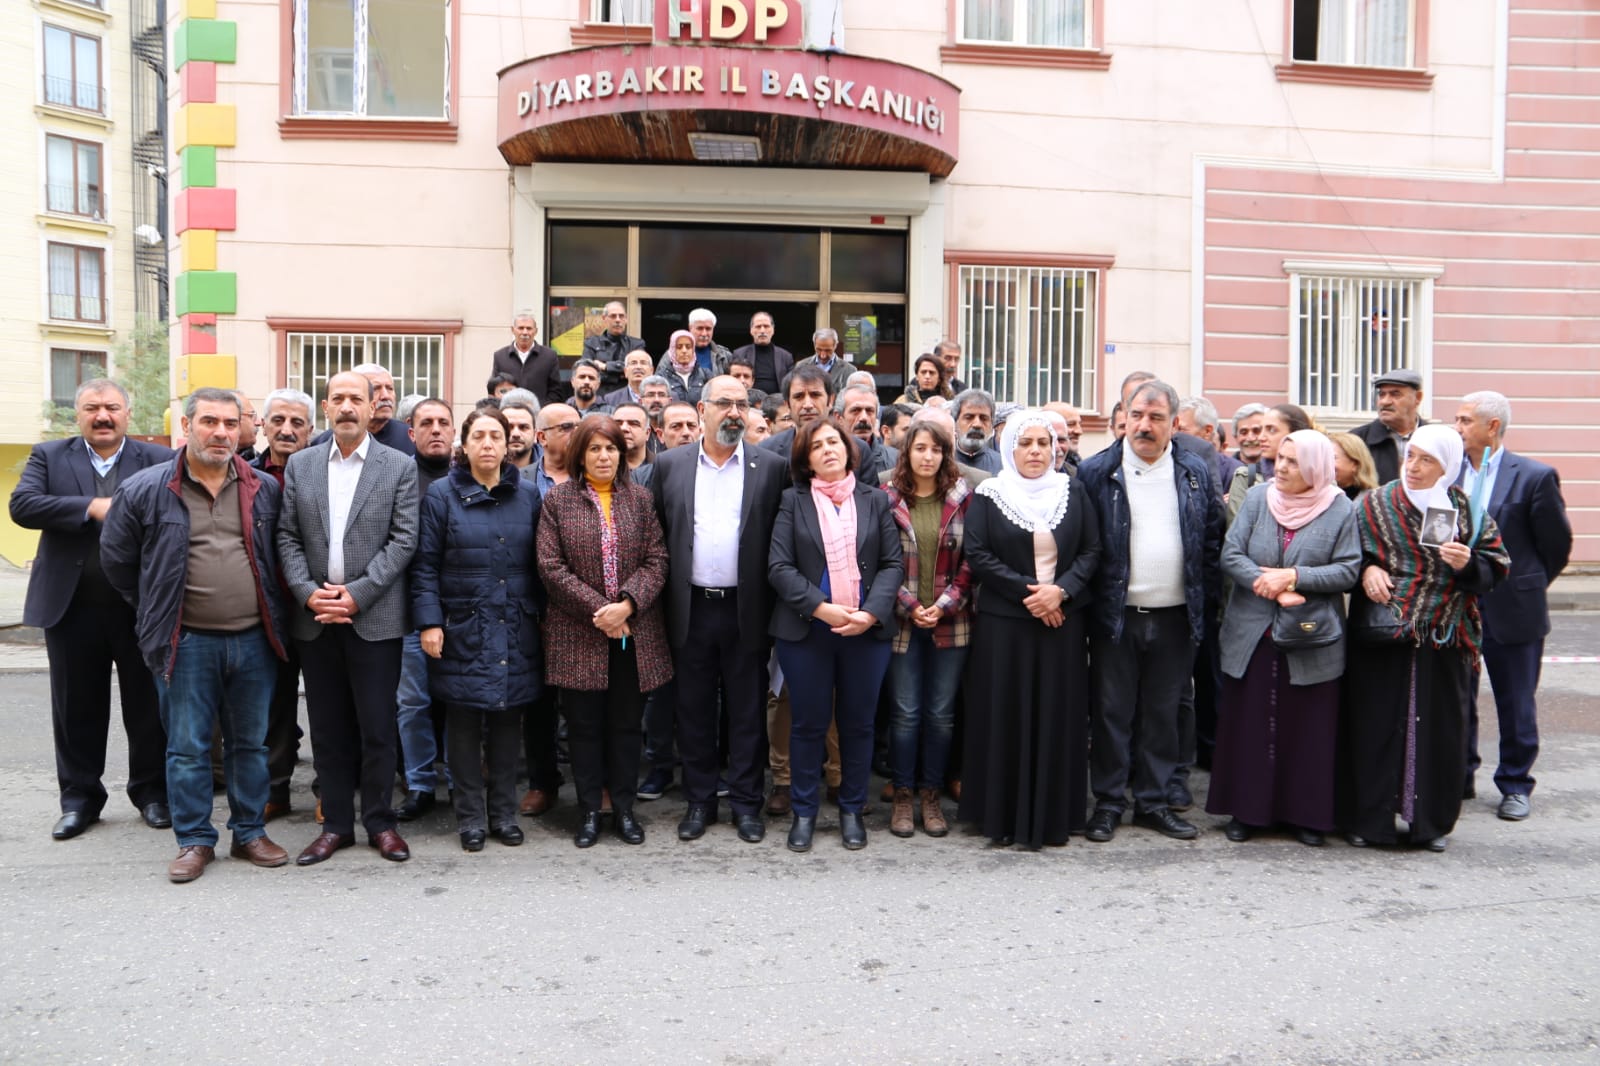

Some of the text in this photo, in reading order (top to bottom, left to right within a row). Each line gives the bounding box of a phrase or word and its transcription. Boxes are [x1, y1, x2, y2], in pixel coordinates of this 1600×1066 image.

[668, 0, 789, 40] HDP
[517, 66, 705, 117] DİYARBAKIR
[762, 67, 944, 134] BAŞKANLIĞI
